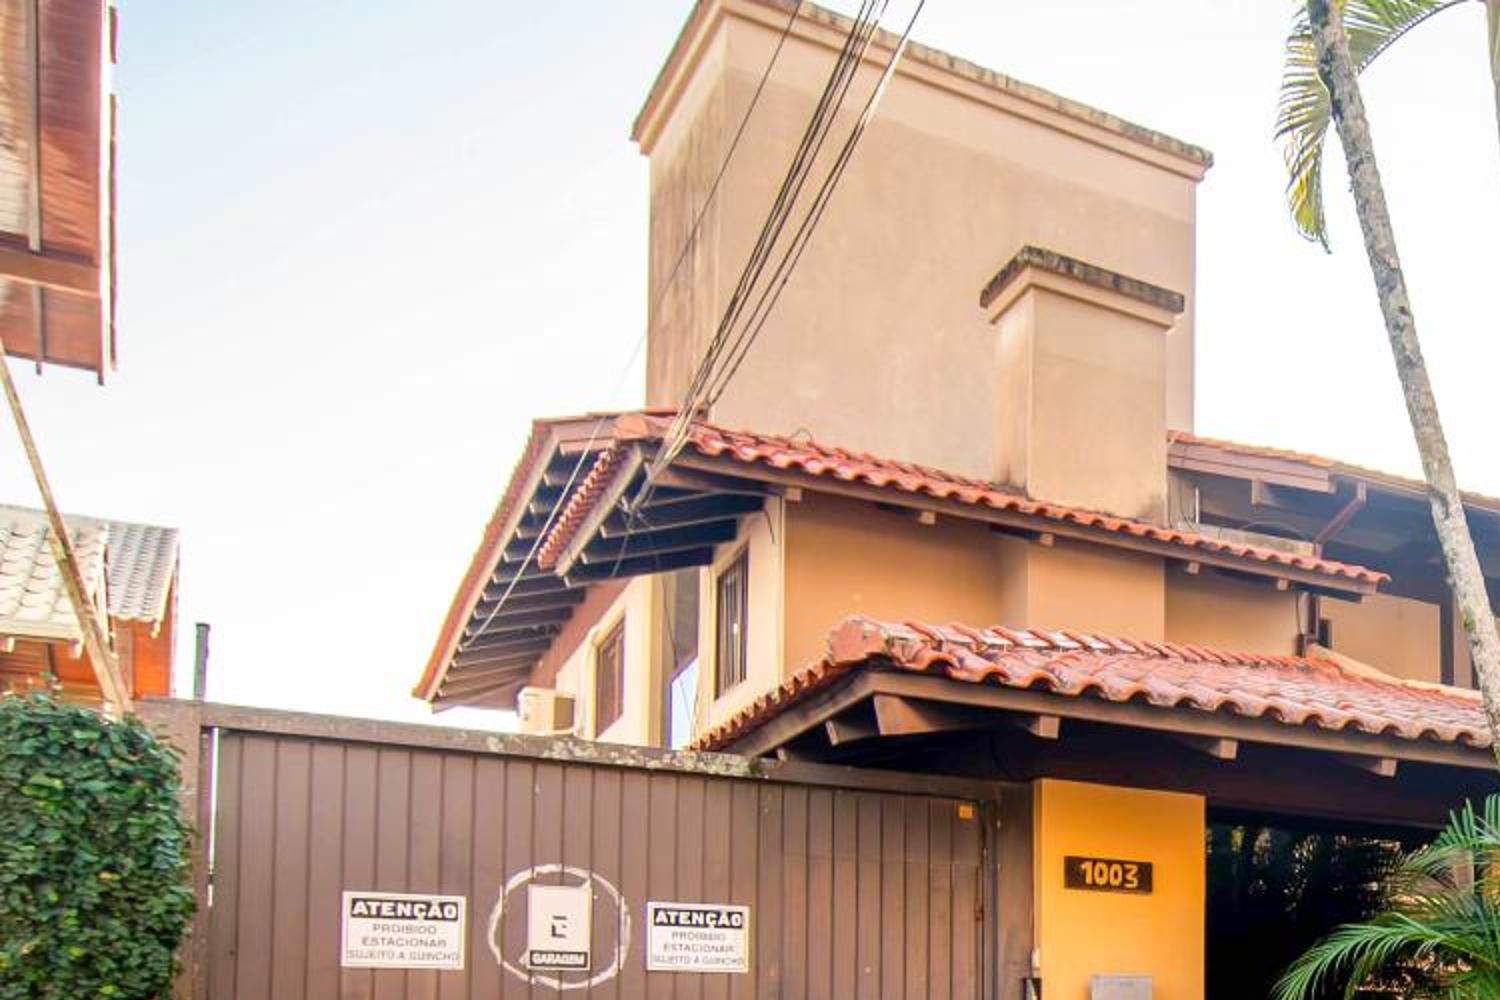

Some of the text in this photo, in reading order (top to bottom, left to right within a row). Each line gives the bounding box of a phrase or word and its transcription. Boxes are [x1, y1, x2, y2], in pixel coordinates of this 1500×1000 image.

[1081, 861, 1139, 888] 1003
[352, 899, 457, 921] ATENÇÃO
[655, 909, 742, 929] ATENÇÃO
[372, 923, 437, 934] PROIBIDO
[361, 936, 447, 948] ESTACIONAR
